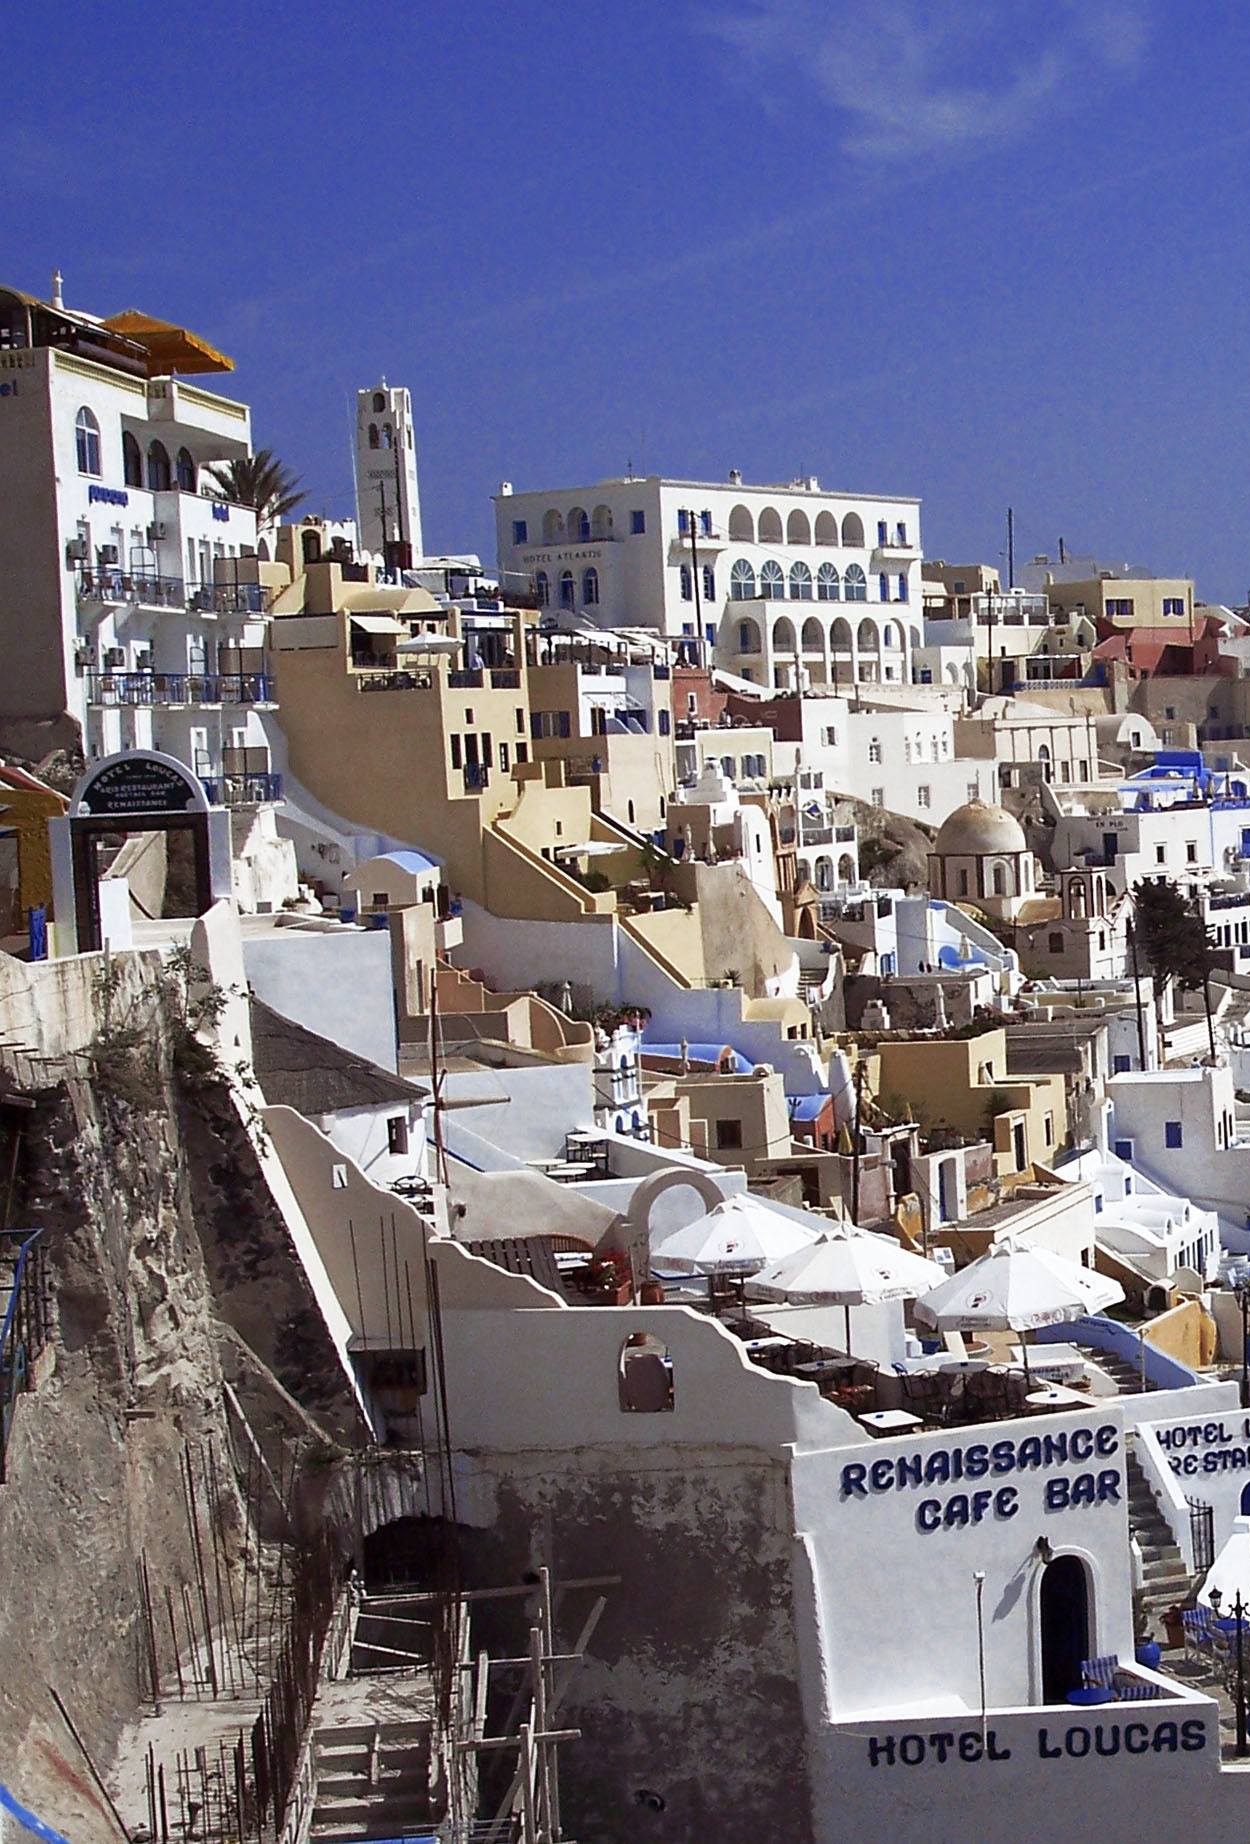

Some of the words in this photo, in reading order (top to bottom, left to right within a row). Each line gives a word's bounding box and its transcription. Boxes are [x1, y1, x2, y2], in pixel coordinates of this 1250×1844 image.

[523, 553, 551, 563] HOTEL
[93, 763, 131, 791] HOTEL
[145, 762, 184, 786] LOUCAS
[120, 782, 175, 793] RESTAURANT
[1156, 1422, 1233, 1450] HOTEL
[841, 1424, 1119, 1496] RENAISSANCE
[917, 1486, 1019, 1531] CAFE
[1045, 1469, 1122, 1509] BAR
[868, 1730, 1011, 1767] HOTEL
[1039, 1719, 1206, 1759] LOUCAS
